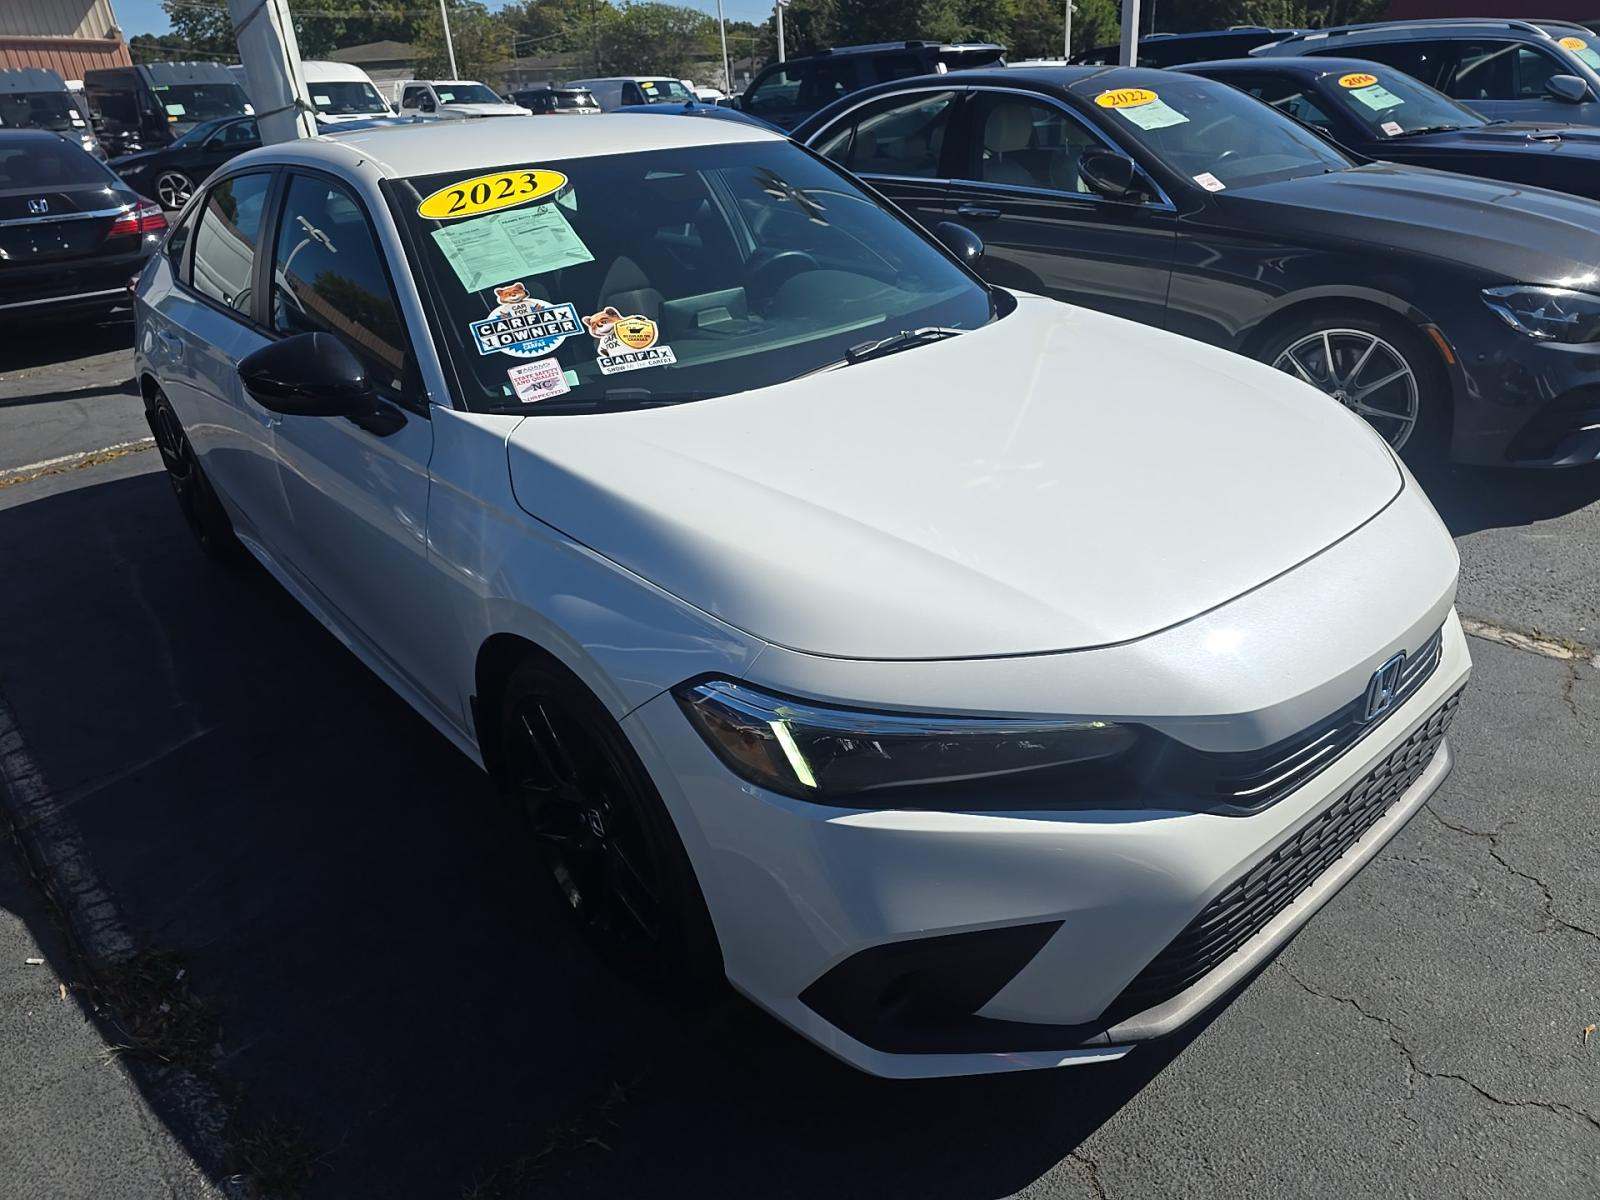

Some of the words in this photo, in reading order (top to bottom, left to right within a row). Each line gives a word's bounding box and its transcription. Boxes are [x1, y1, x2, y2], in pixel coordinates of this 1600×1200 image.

[1107, 90, 1147, 105] 2022
[446, 173, 538, 214] 2023
[512, 303, 527, 311] CAR
[478, 311, 571, 336] CARFAX
[499, 320, 575, 345] OWNER
[602, 349, 670, 367] CARFAX
[648, 357, 673, 366] CARFAX
[514, 373, 533, 382] STATE
[534, 367, 558, 377] SAFETY
[531, 371, 559, 382] QUALITY
[532, 379, 552, 391] NC
